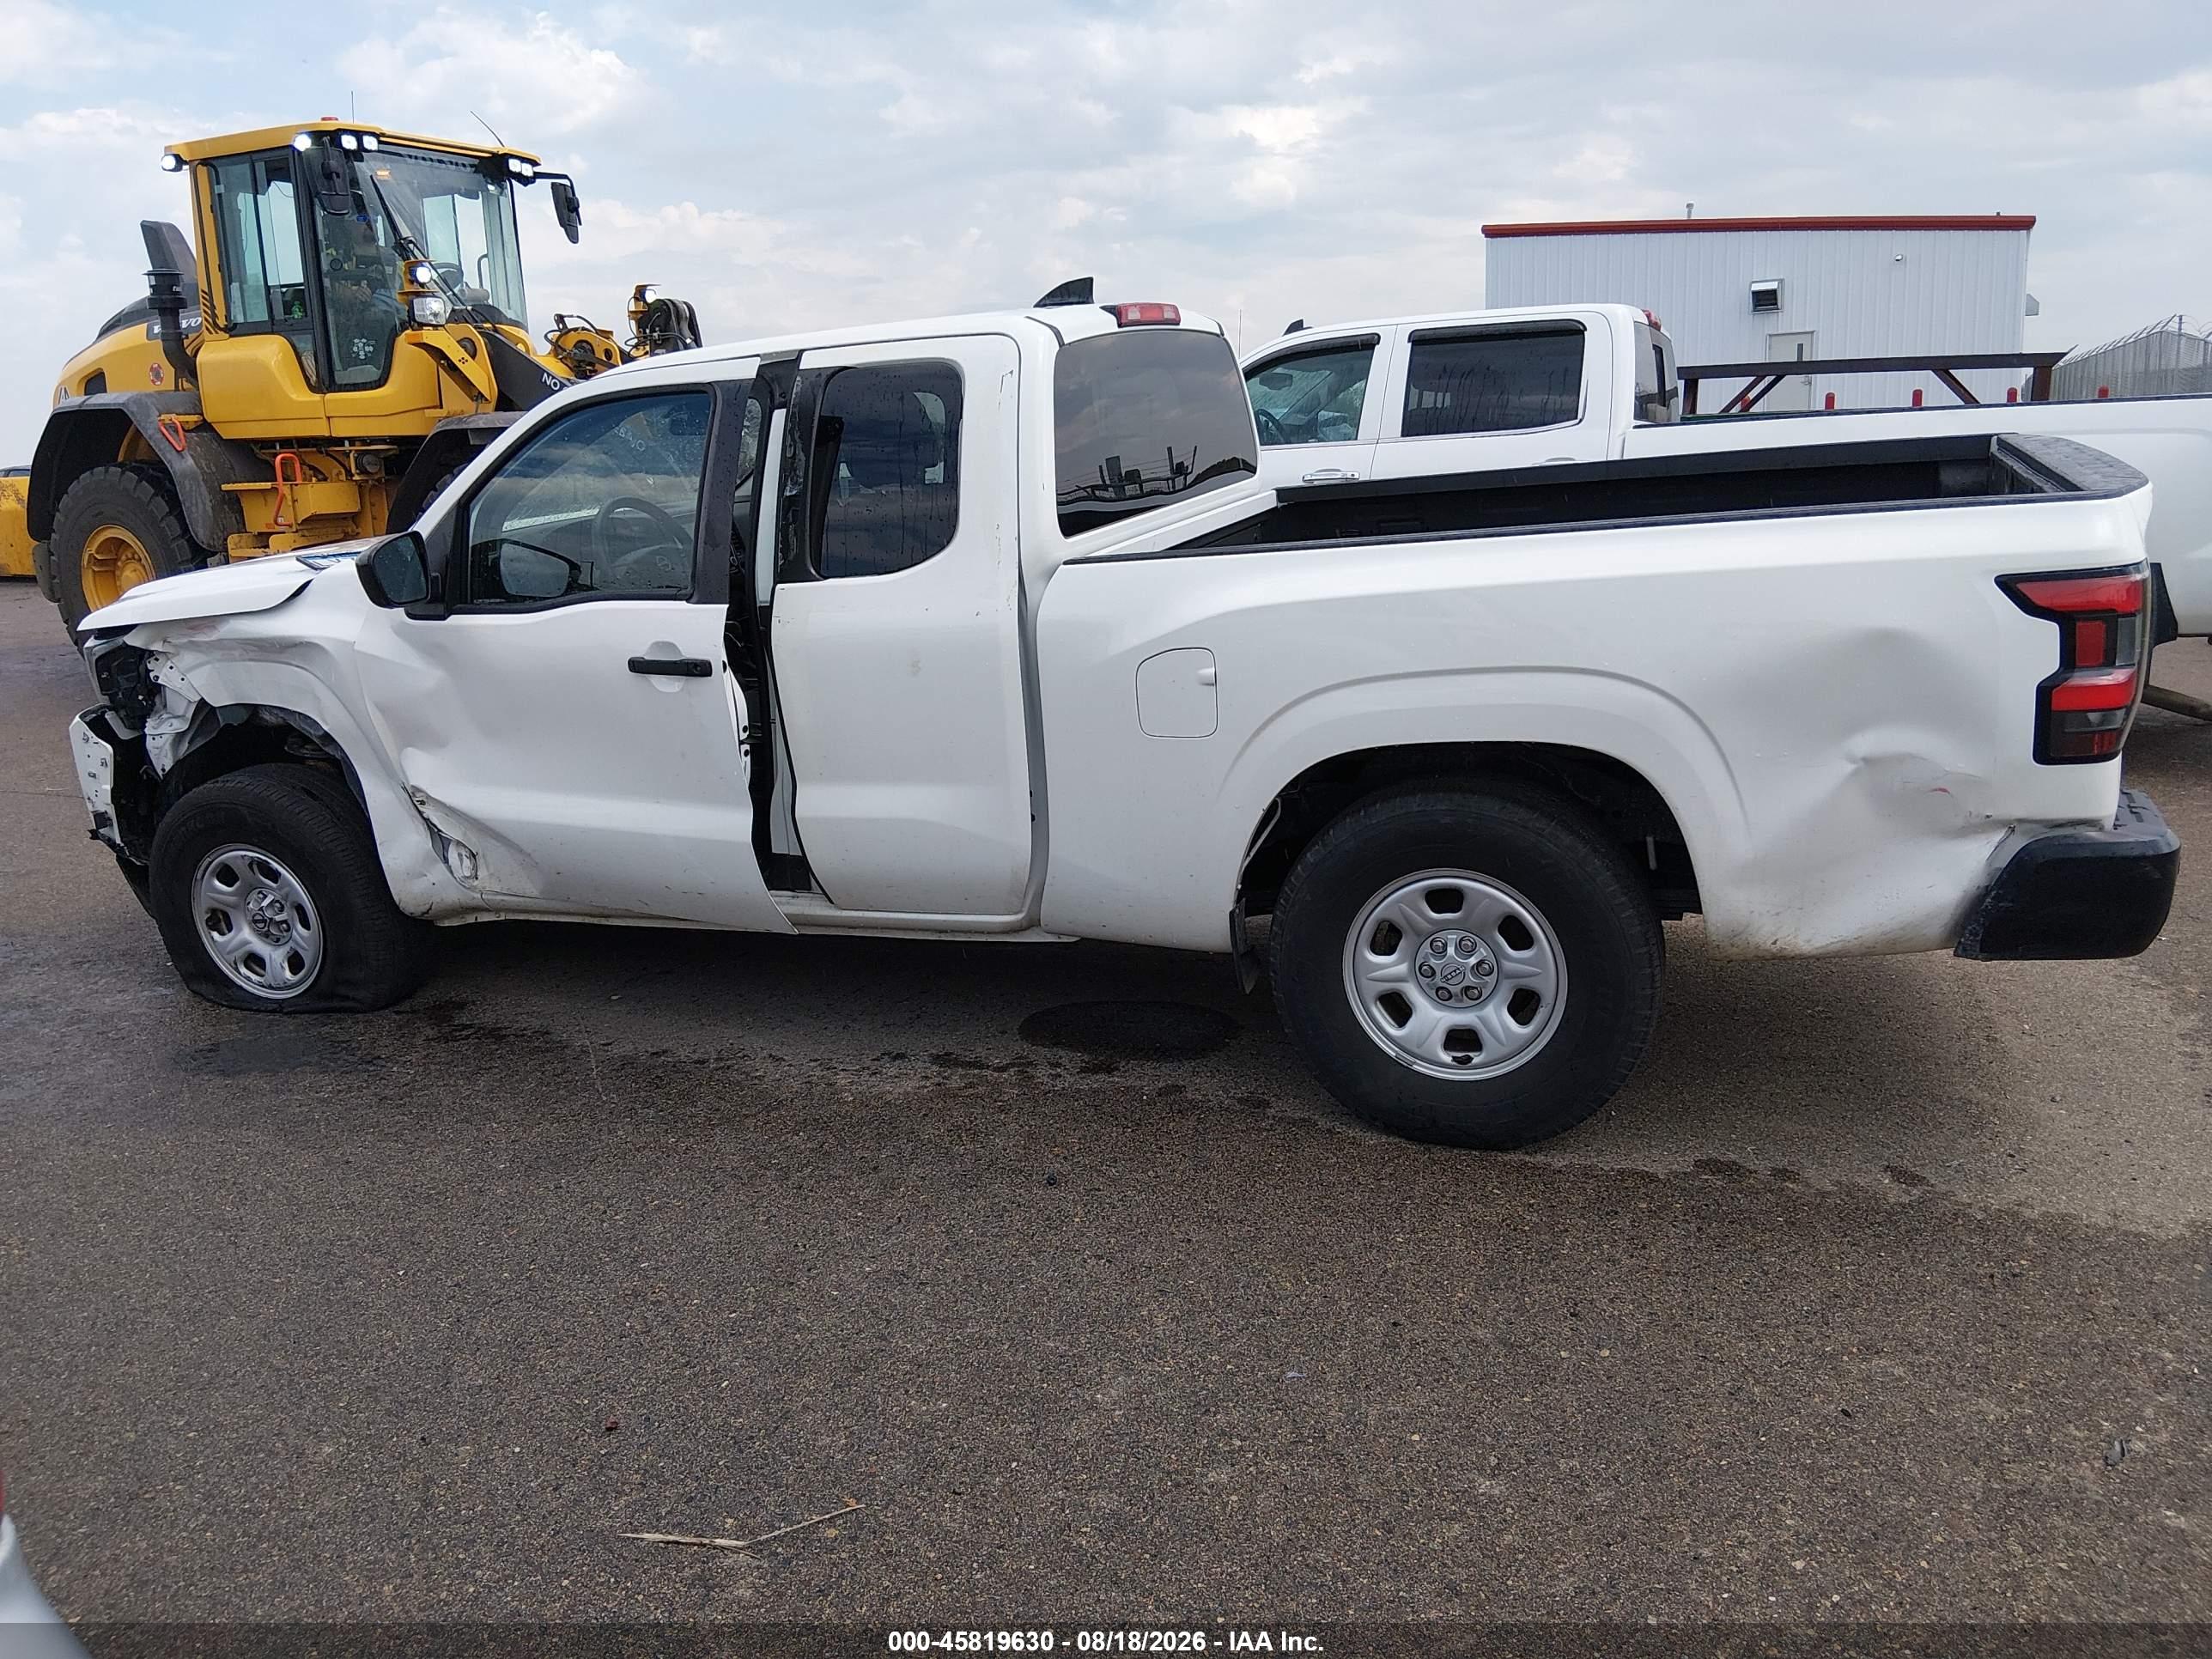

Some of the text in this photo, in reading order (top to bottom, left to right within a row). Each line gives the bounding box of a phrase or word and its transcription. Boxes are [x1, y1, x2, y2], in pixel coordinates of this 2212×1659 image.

[153, 317, 202, 334] VVO
[542, 372, 561, 391] NO
[1440, 965, 1466, 983] NISSAN
